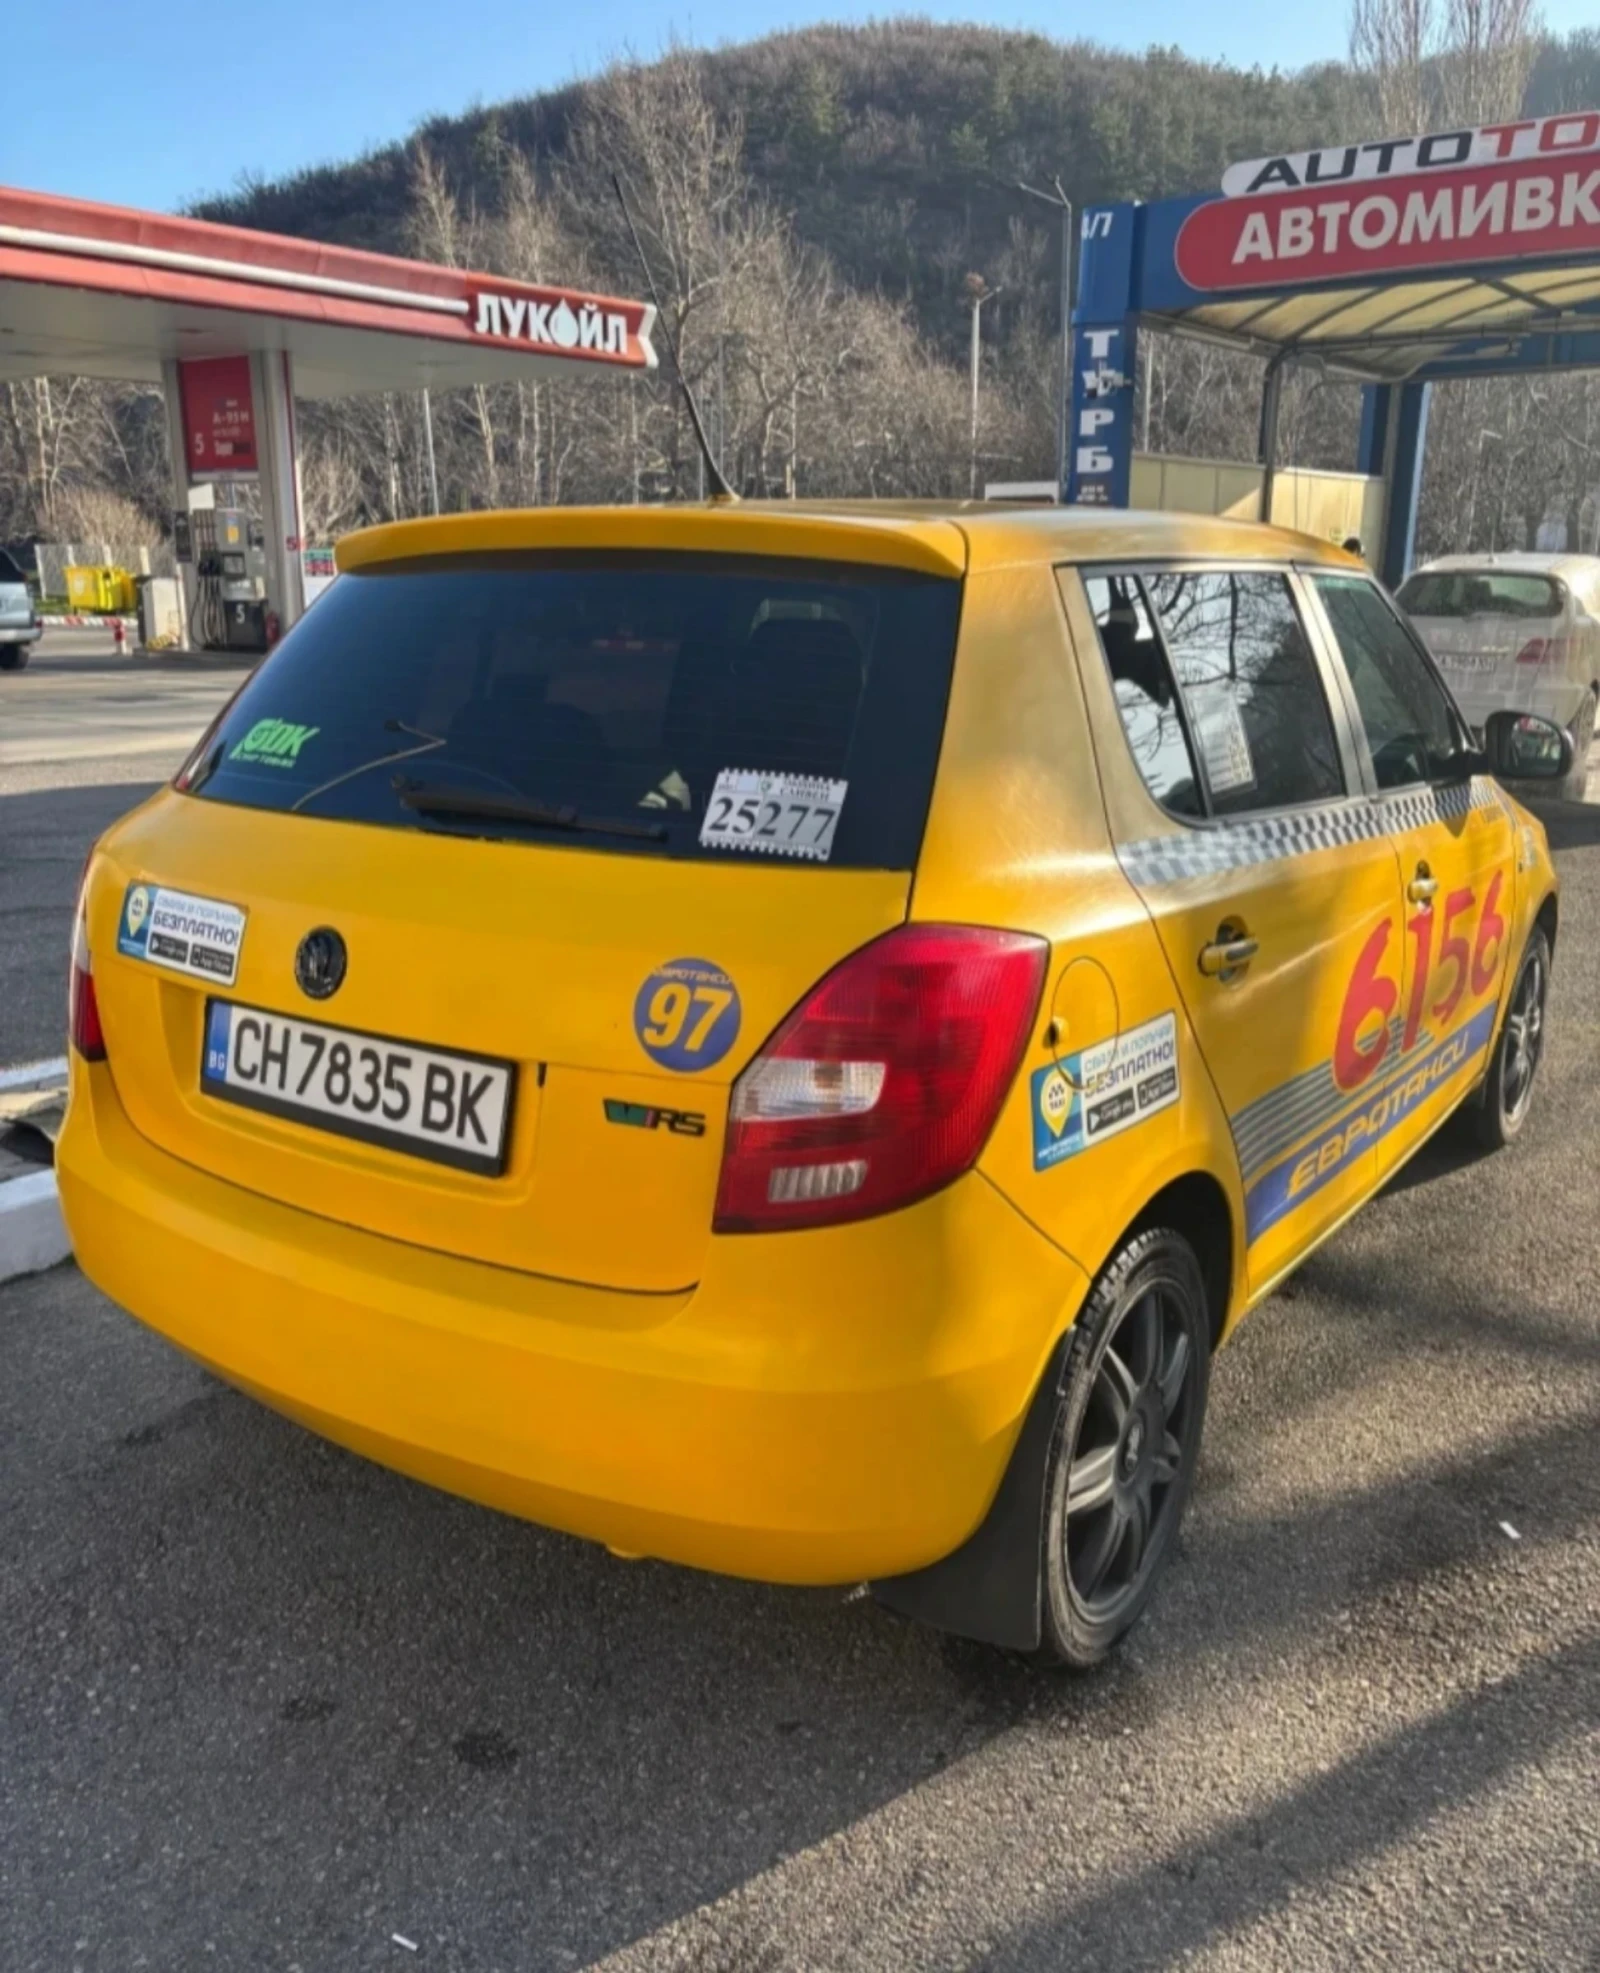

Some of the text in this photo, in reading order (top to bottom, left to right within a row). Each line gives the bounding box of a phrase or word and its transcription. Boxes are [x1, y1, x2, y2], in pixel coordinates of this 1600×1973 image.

[475, 292, 628, 355] ЛУКОЙЛ
[235, 603, 245, 624] 5
[708, 797, 836, 844] 25277
[153, 910, 239, 948] БЕЗПЛАТНО!
[1332, 868, 1504, 1097] 6156
[643, 982, 734, 1053] 97
[208, 1052, 225, 1071] BG
[1084, 1039, 1174, 1098] БЕЗПЛАТНО!
[1287, 1031, 1469, 1199] ЕВРОТАКСИ
